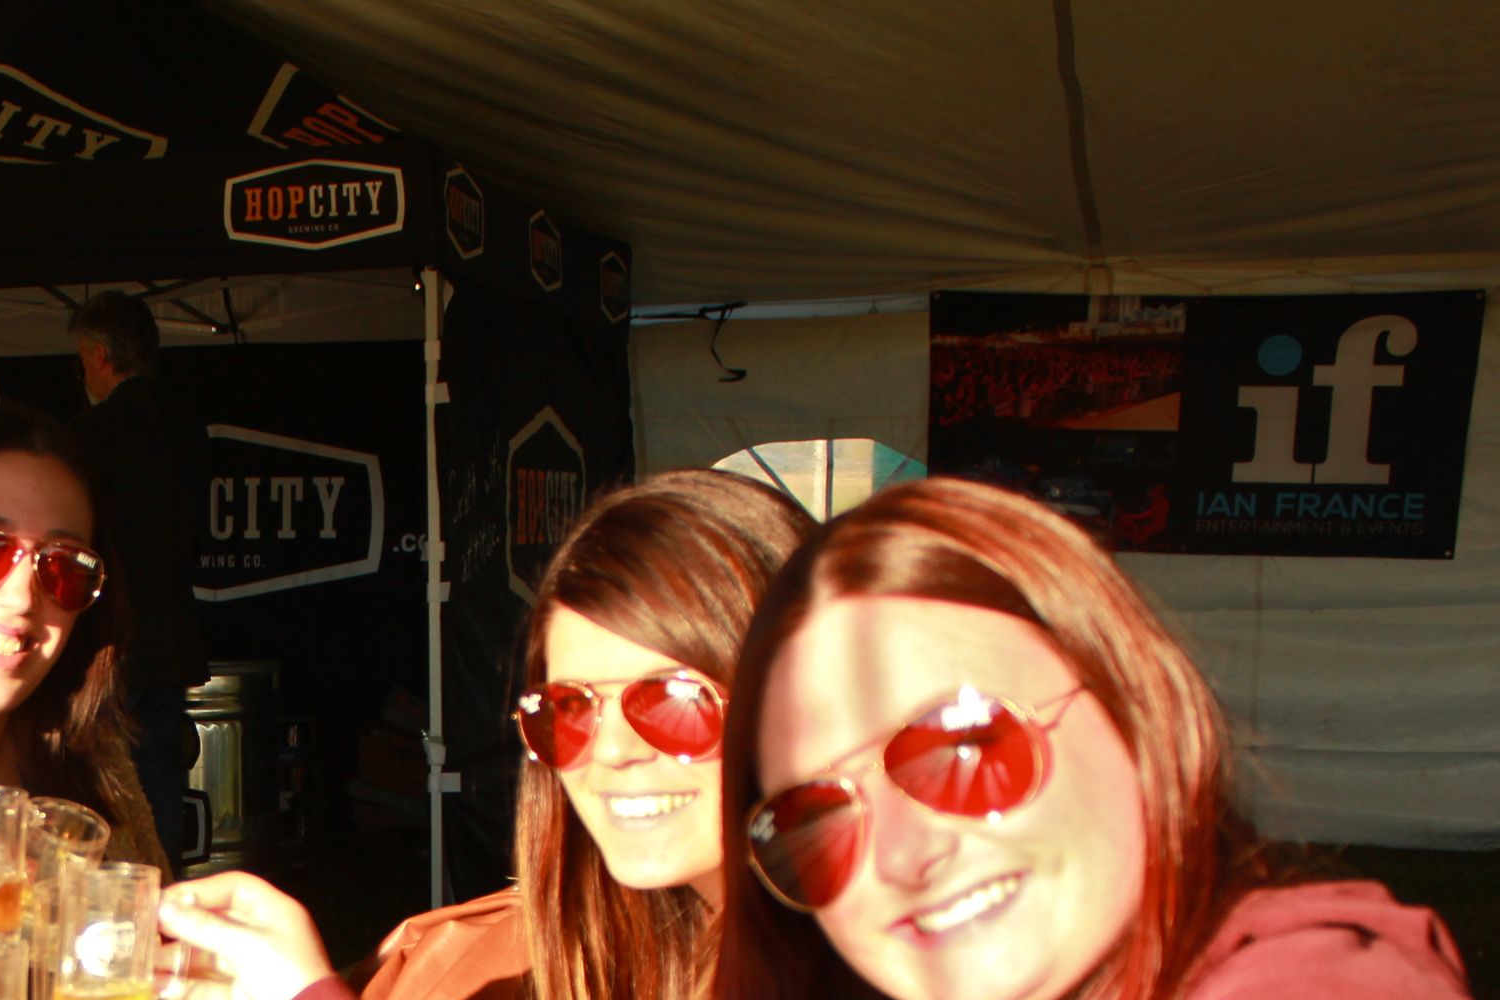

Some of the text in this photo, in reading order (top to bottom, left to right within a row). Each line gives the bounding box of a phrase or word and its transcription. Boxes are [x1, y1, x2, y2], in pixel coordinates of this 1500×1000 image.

[243, 181, 384, 223] HOPCITY
[1232, 314, 1418, 485] if
[1196, 491, 1427, 520] IAN FRANCE
[1195, 519, 1334, 535] ENTERTAINMENT
[1356, 521, 1425, 537] EVENTS
[197, 554, 236, 568] WING
